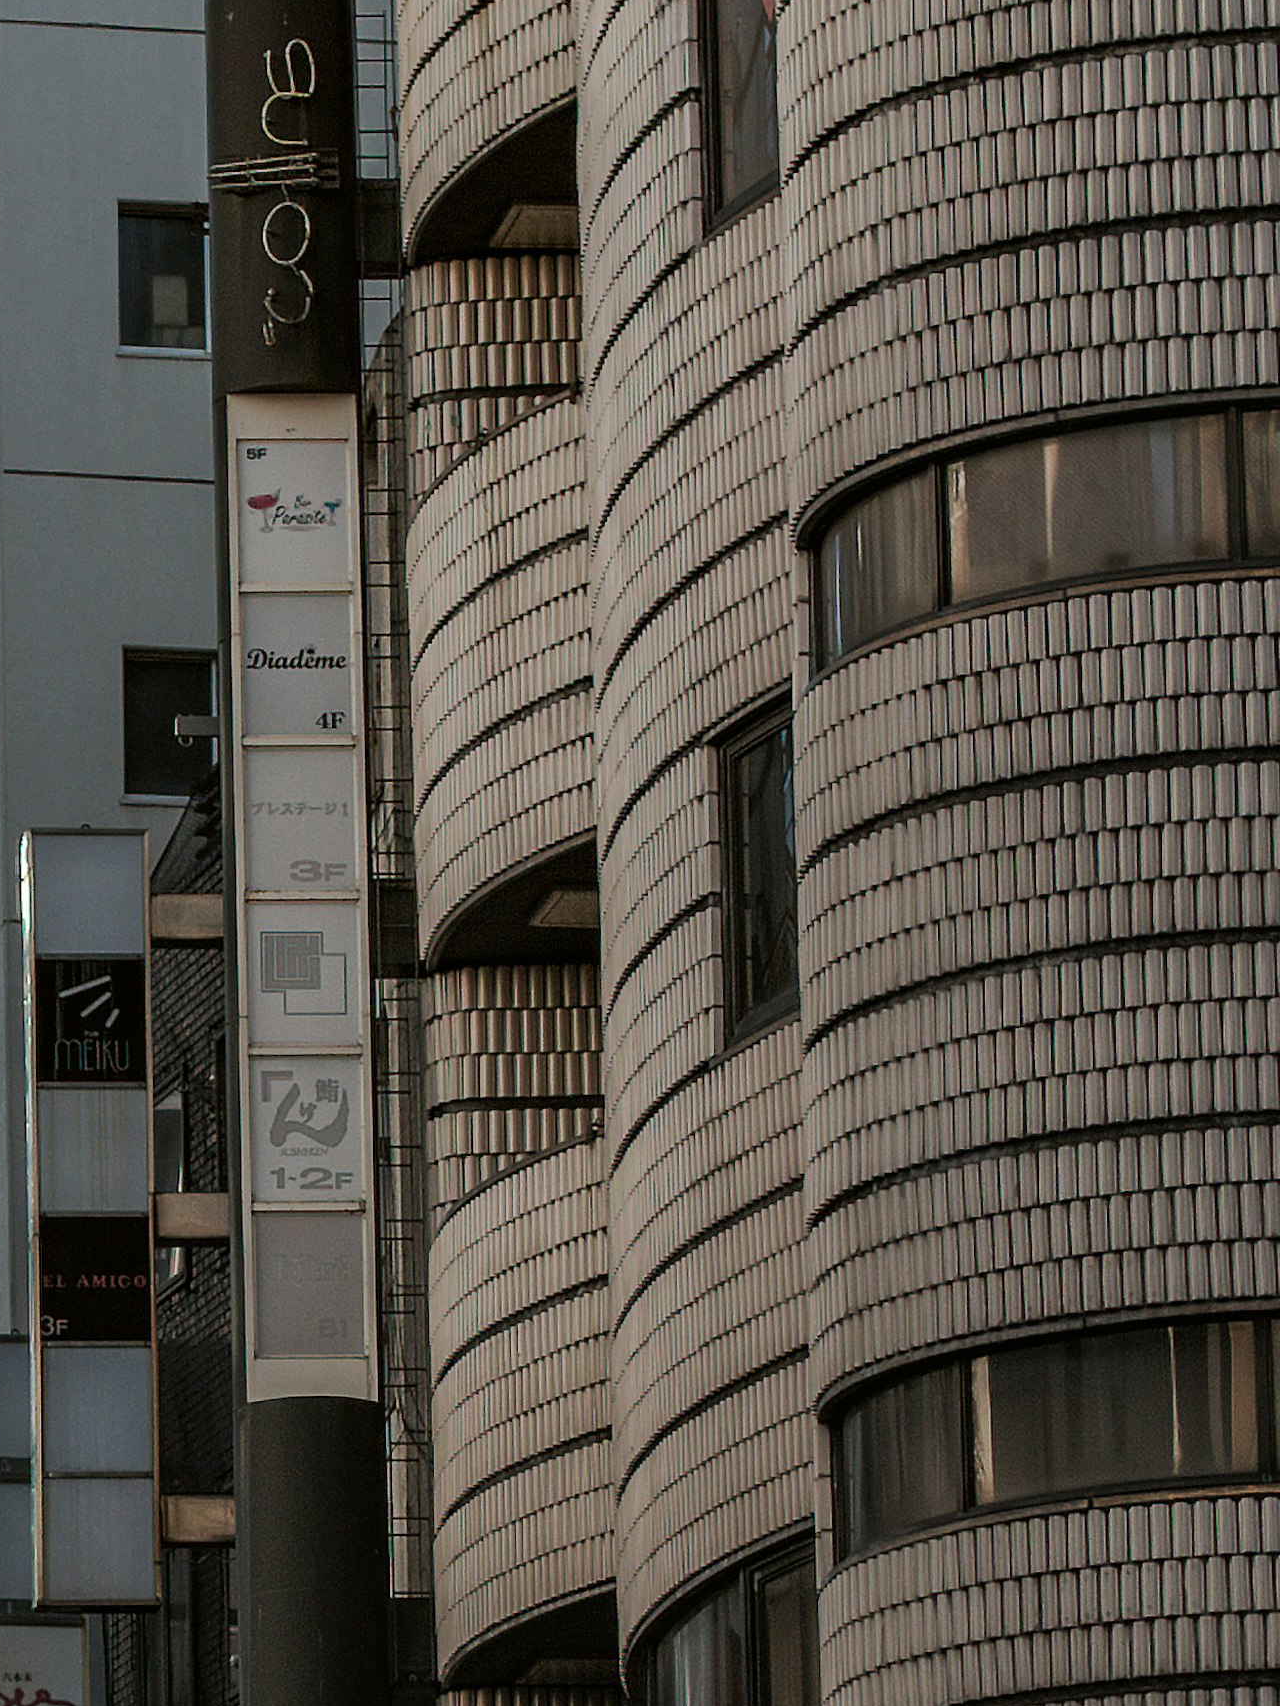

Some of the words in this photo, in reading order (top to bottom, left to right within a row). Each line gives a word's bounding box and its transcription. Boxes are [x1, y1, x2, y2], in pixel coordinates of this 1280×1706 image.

[246, 448, 267, 460] 5F
[315, 711, 346, 729] 4F
[289, 860, 347, 882] 3F
[42, 1273, 66, 1288] EL
[76, 1273, 147, 1289] AMIGO
[40, 1314, 70, 1336] 3F
